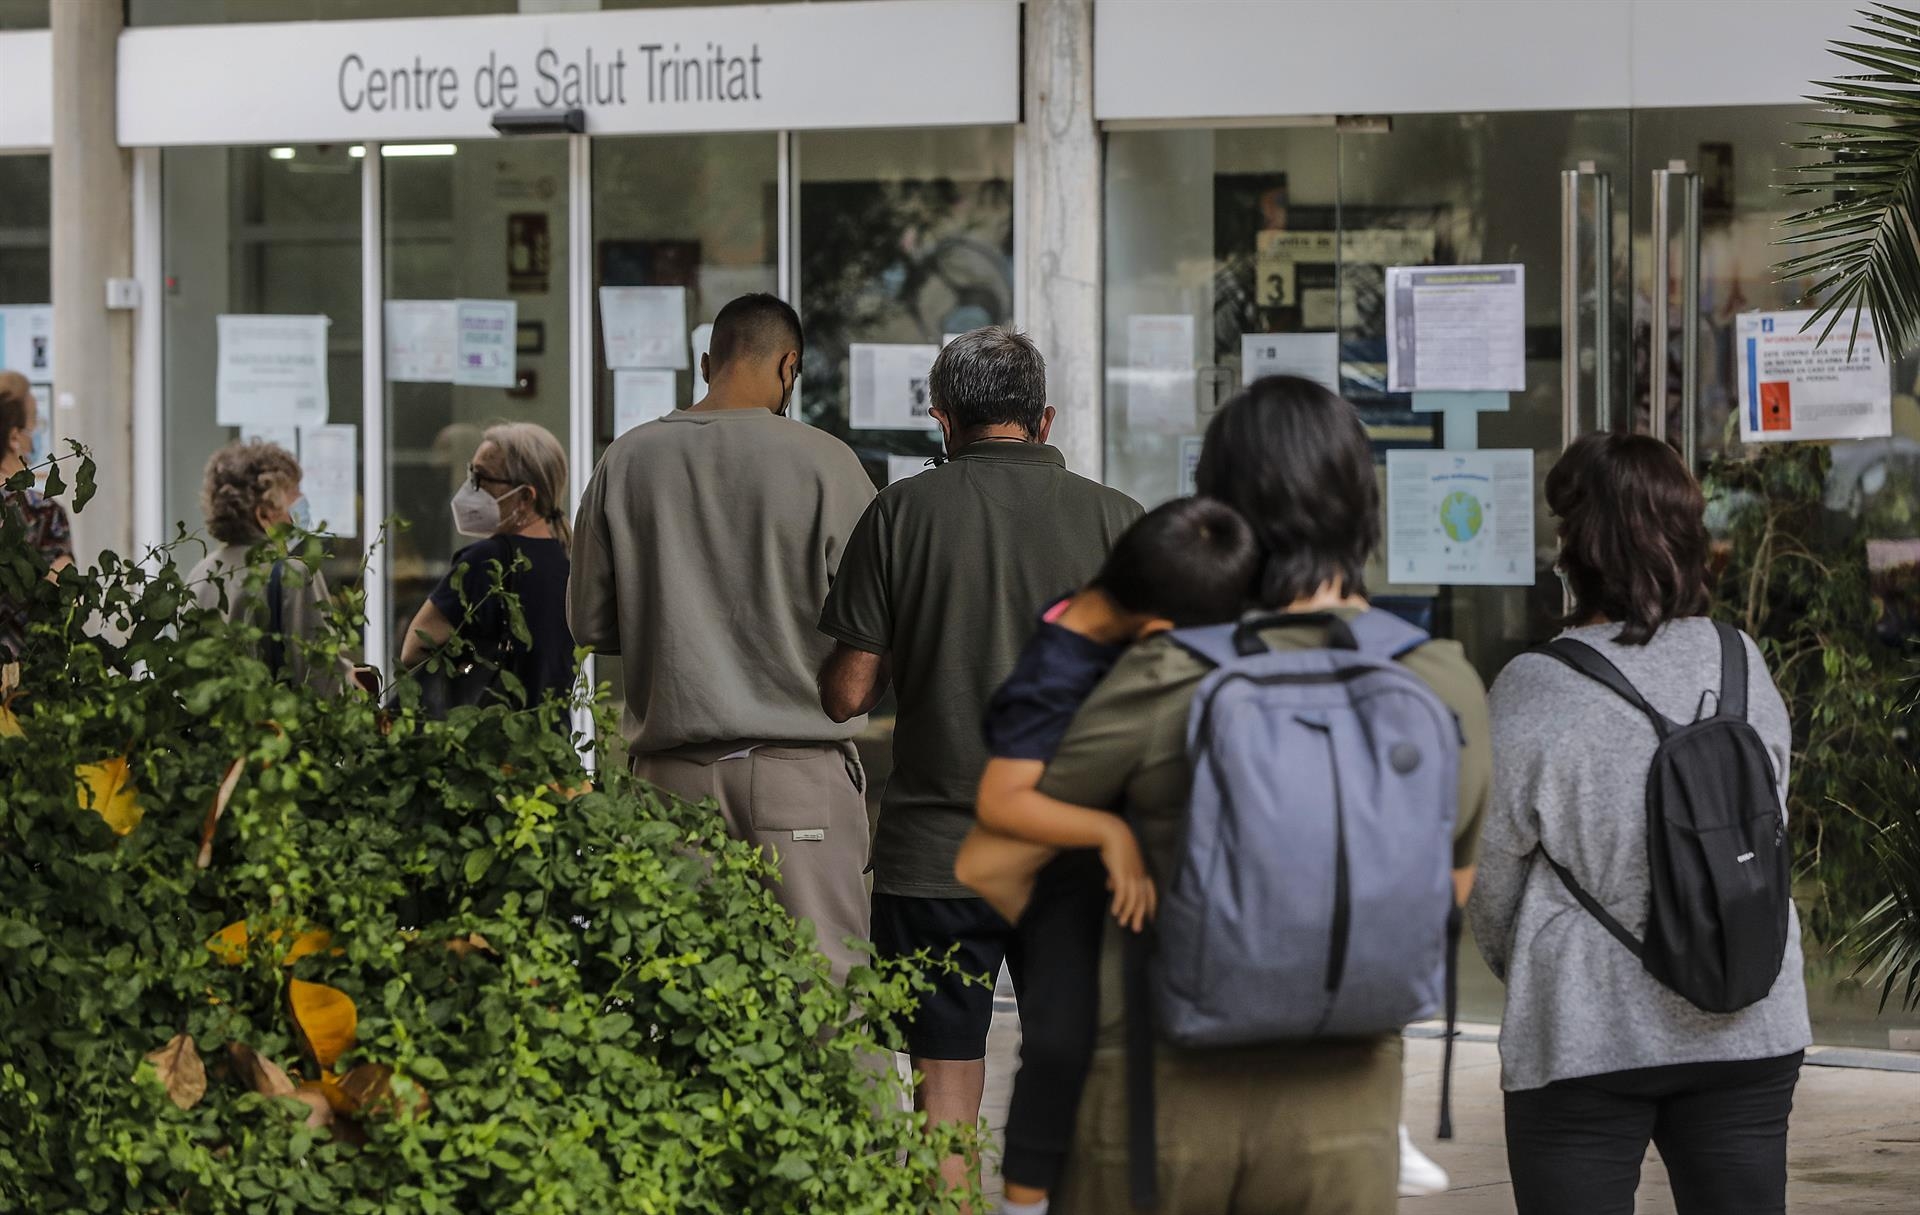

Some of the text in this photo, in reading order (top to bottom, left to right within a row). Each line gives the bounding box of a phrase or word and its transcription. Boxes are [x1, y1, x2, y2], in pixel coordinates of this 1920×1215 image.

[338, 42, 763, 112] Centre de Salut Trinitat
[1267, 274, 1285, 303] 3
